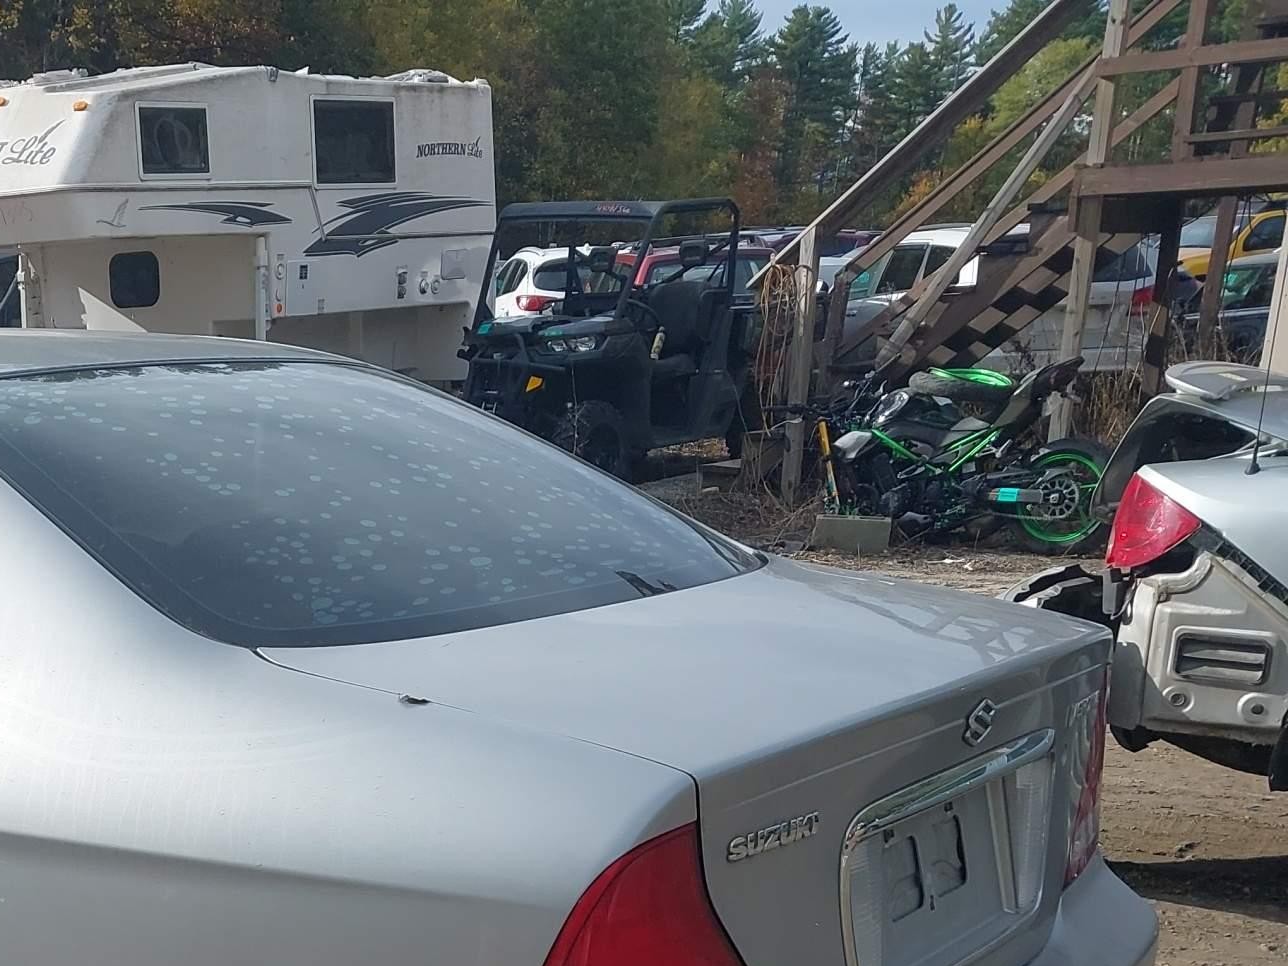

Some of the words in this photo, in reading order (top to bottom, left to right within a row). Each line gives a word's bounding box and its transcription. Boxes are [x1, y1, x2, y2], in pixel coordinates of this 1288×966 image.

[2, 121, 65, 166] Lite
[415, 142, 467, 159] NORTHERN
[726, 811, 821, 862] SUZUKI
